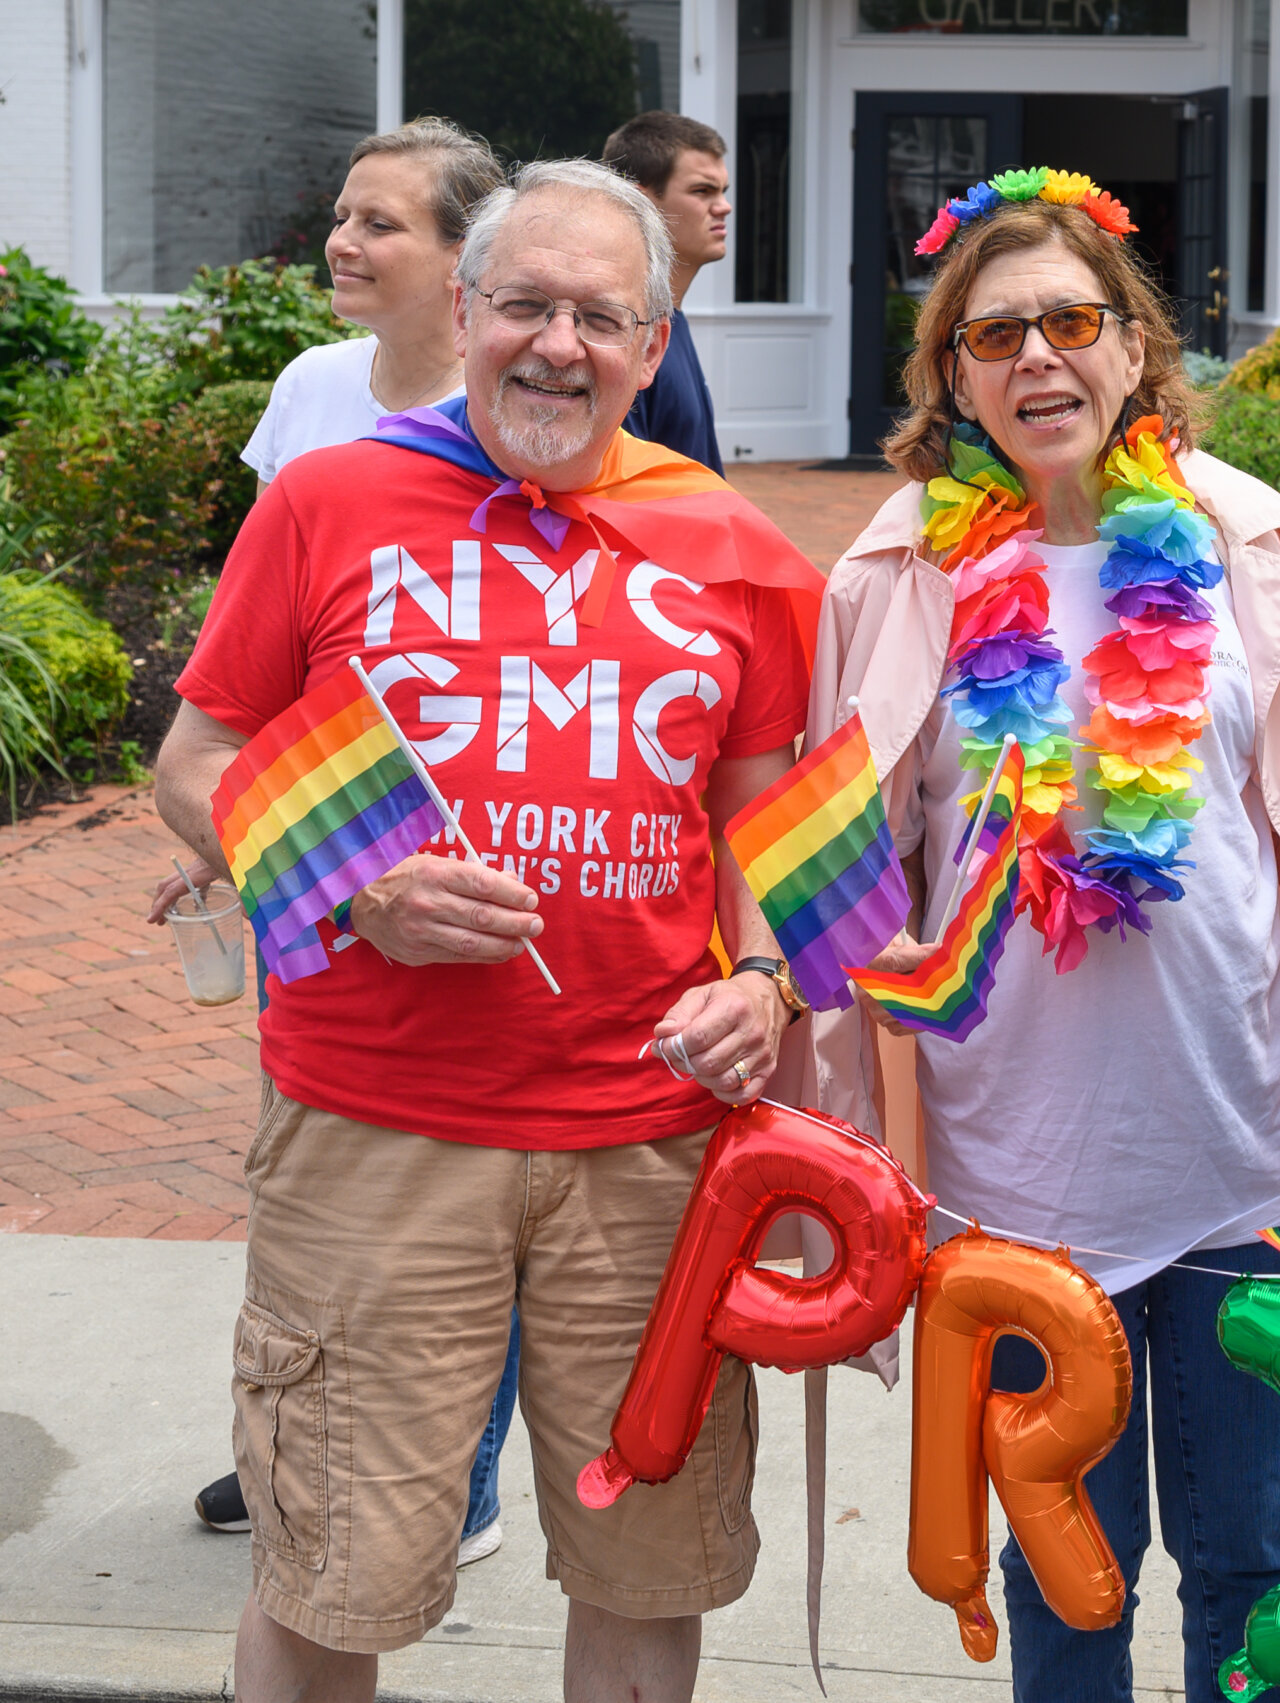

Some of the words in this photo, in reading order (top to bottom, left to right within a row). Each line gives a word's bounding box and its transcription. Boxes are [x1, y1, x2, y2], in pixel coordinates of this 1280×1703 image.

[364, 540, 722, 656] NYC
[365, 652, 722, 786] GMC
[484, 800, 612, 855] YORK
[629, 812, 683, 859] CITY
[579, 860, 681, 900] CHORUS
